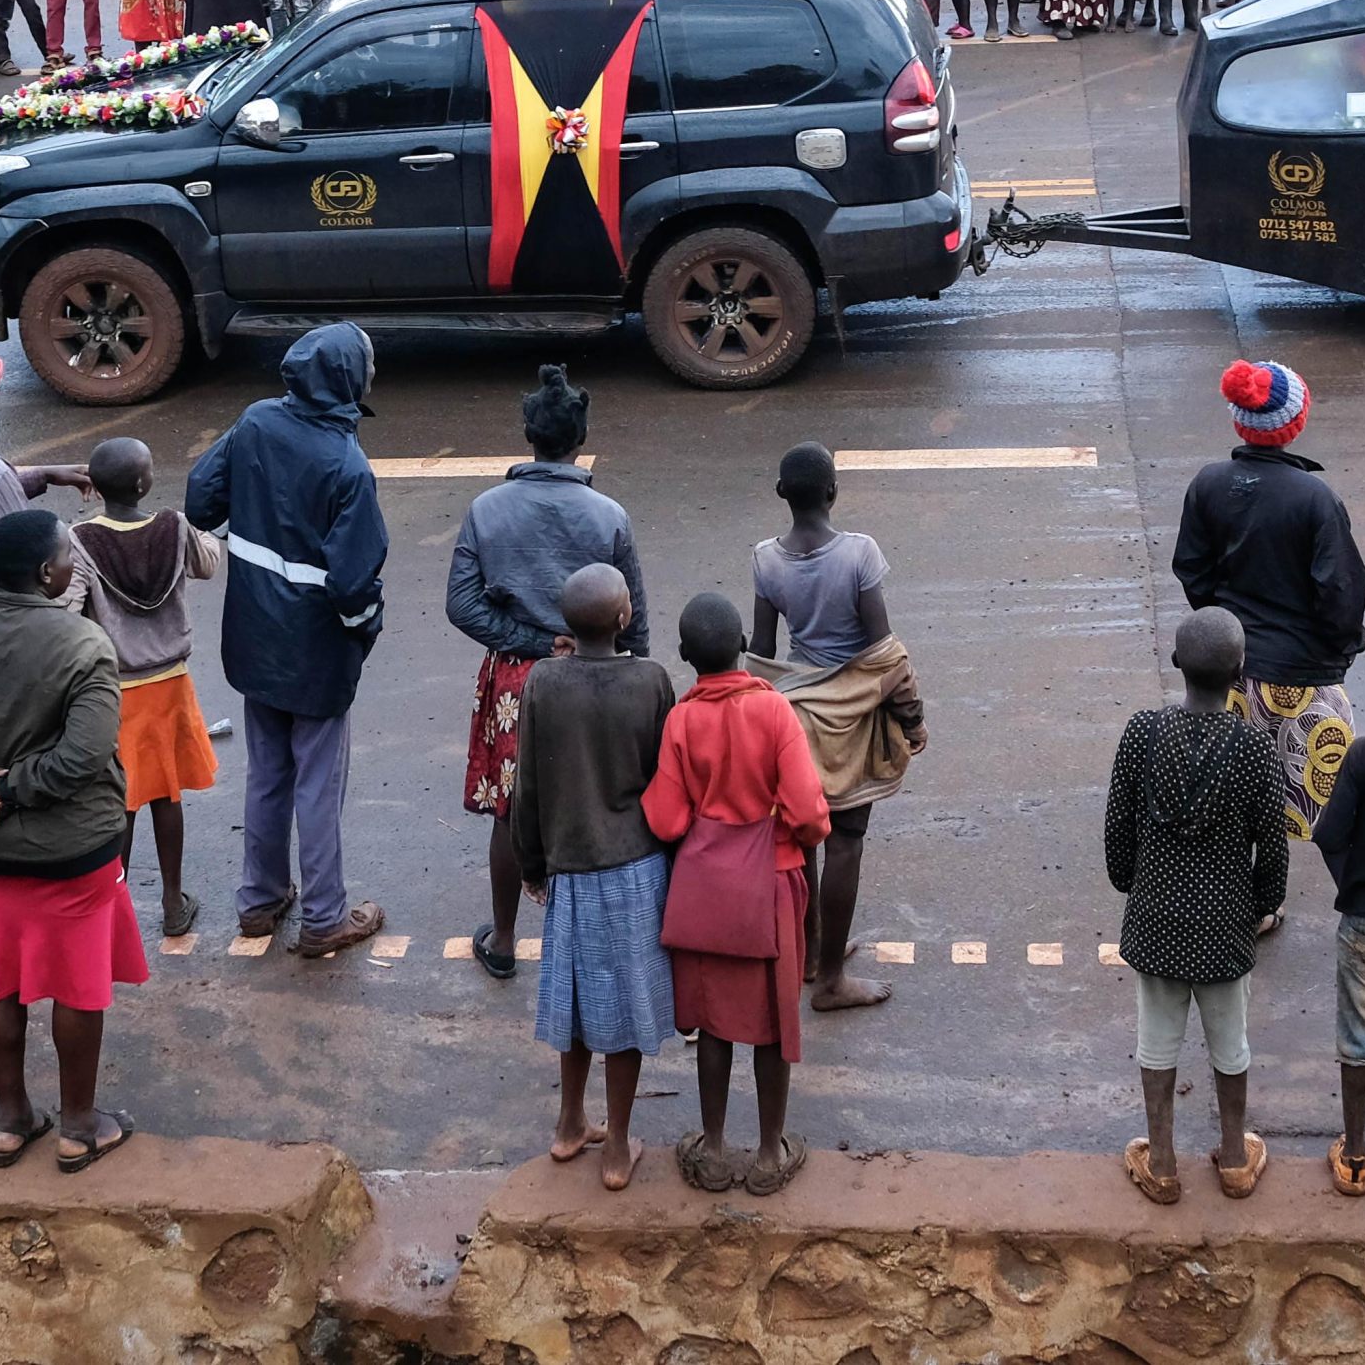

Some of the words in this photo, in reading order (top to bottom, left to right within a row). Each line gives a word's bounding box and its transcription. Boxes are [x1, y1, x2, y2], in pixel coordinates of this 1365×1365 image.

[1270, 198, 1327, 210] COLMOR
[319, 216, 374, 227] COLMOR
[1259, 218, 1287, 229] 0712
[1288, 220, 1310, 230] 547
[1312, 221, 1335, 231] 582
[1259, 229, 1289, 240] 0735
[1290, 231, 1312, 241] 547
[1314, 232, 1337, 243] 582
